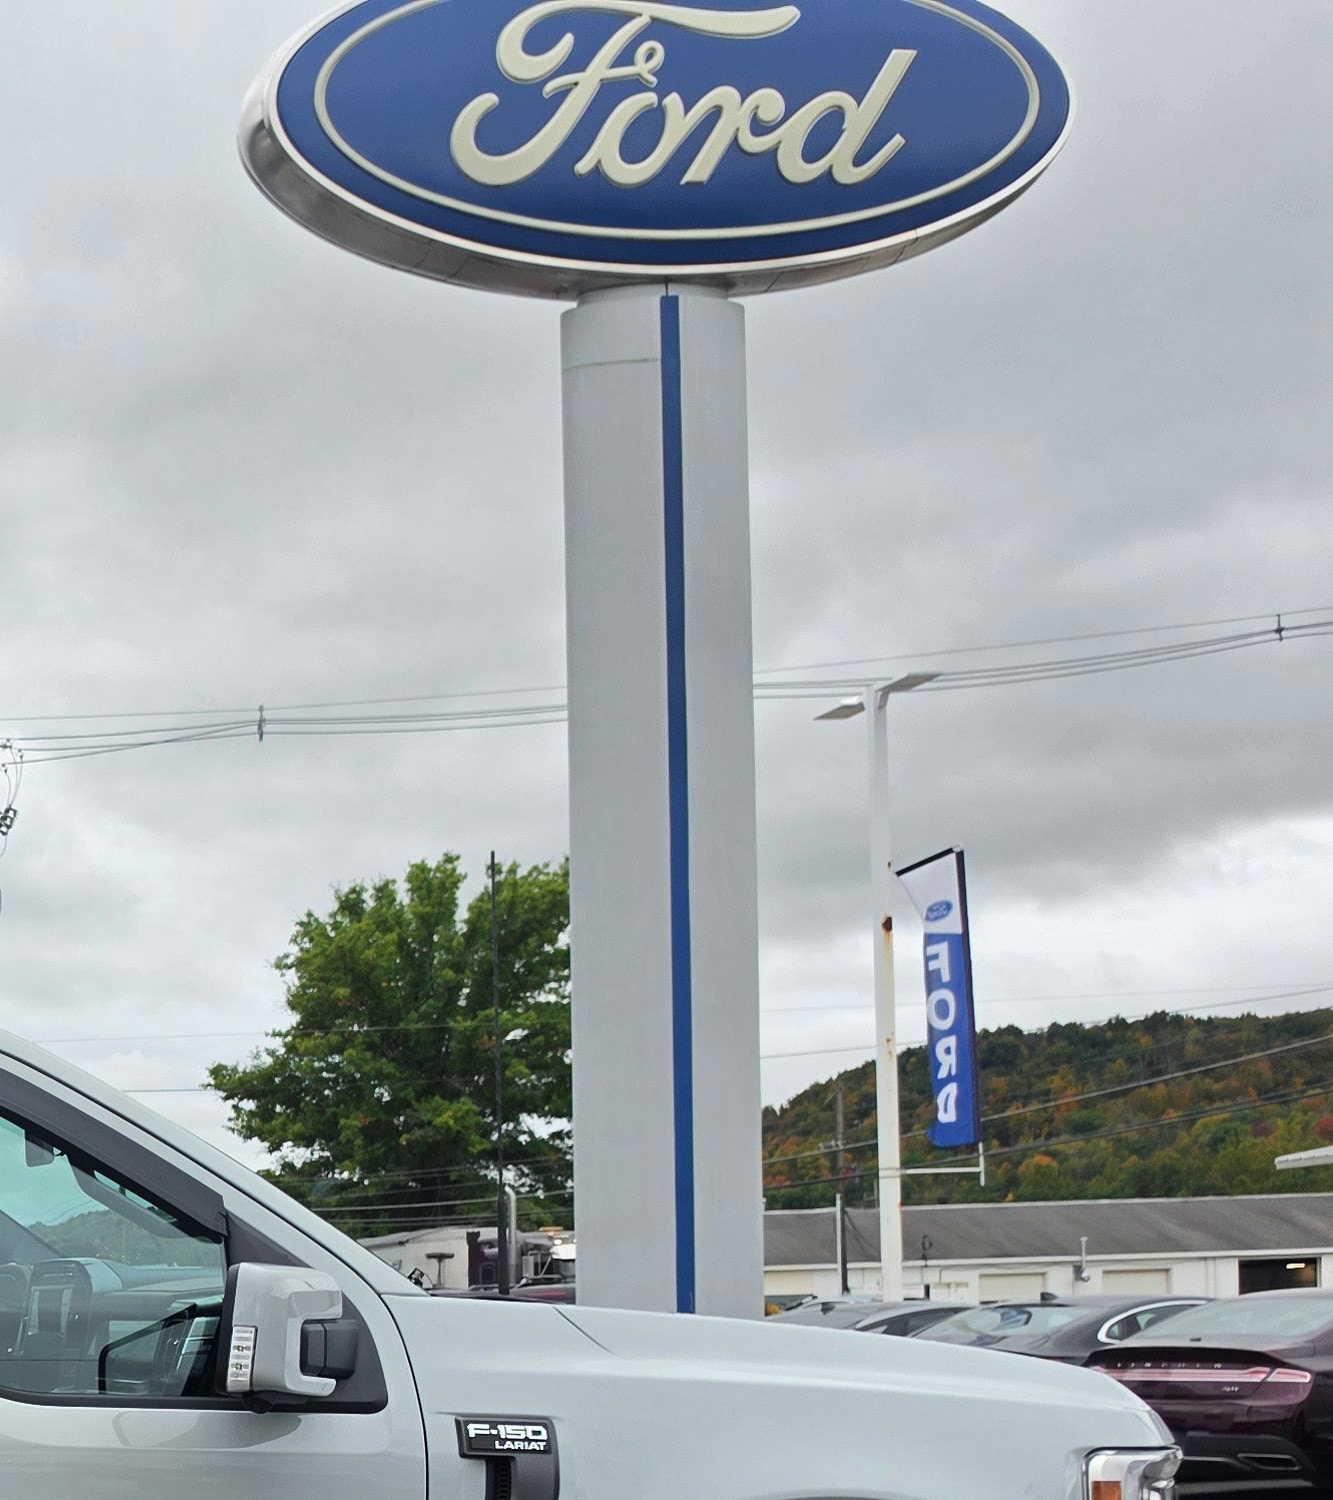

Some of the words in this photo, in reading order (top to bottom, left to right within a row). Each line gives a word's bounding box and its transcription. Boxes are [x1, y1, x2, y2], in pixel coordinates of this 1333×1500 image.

[450, 0, 918, 189] Ford
[466, 1423, 549, 1440] F-150
[494, 1440, 547, 1451] LARIAT
